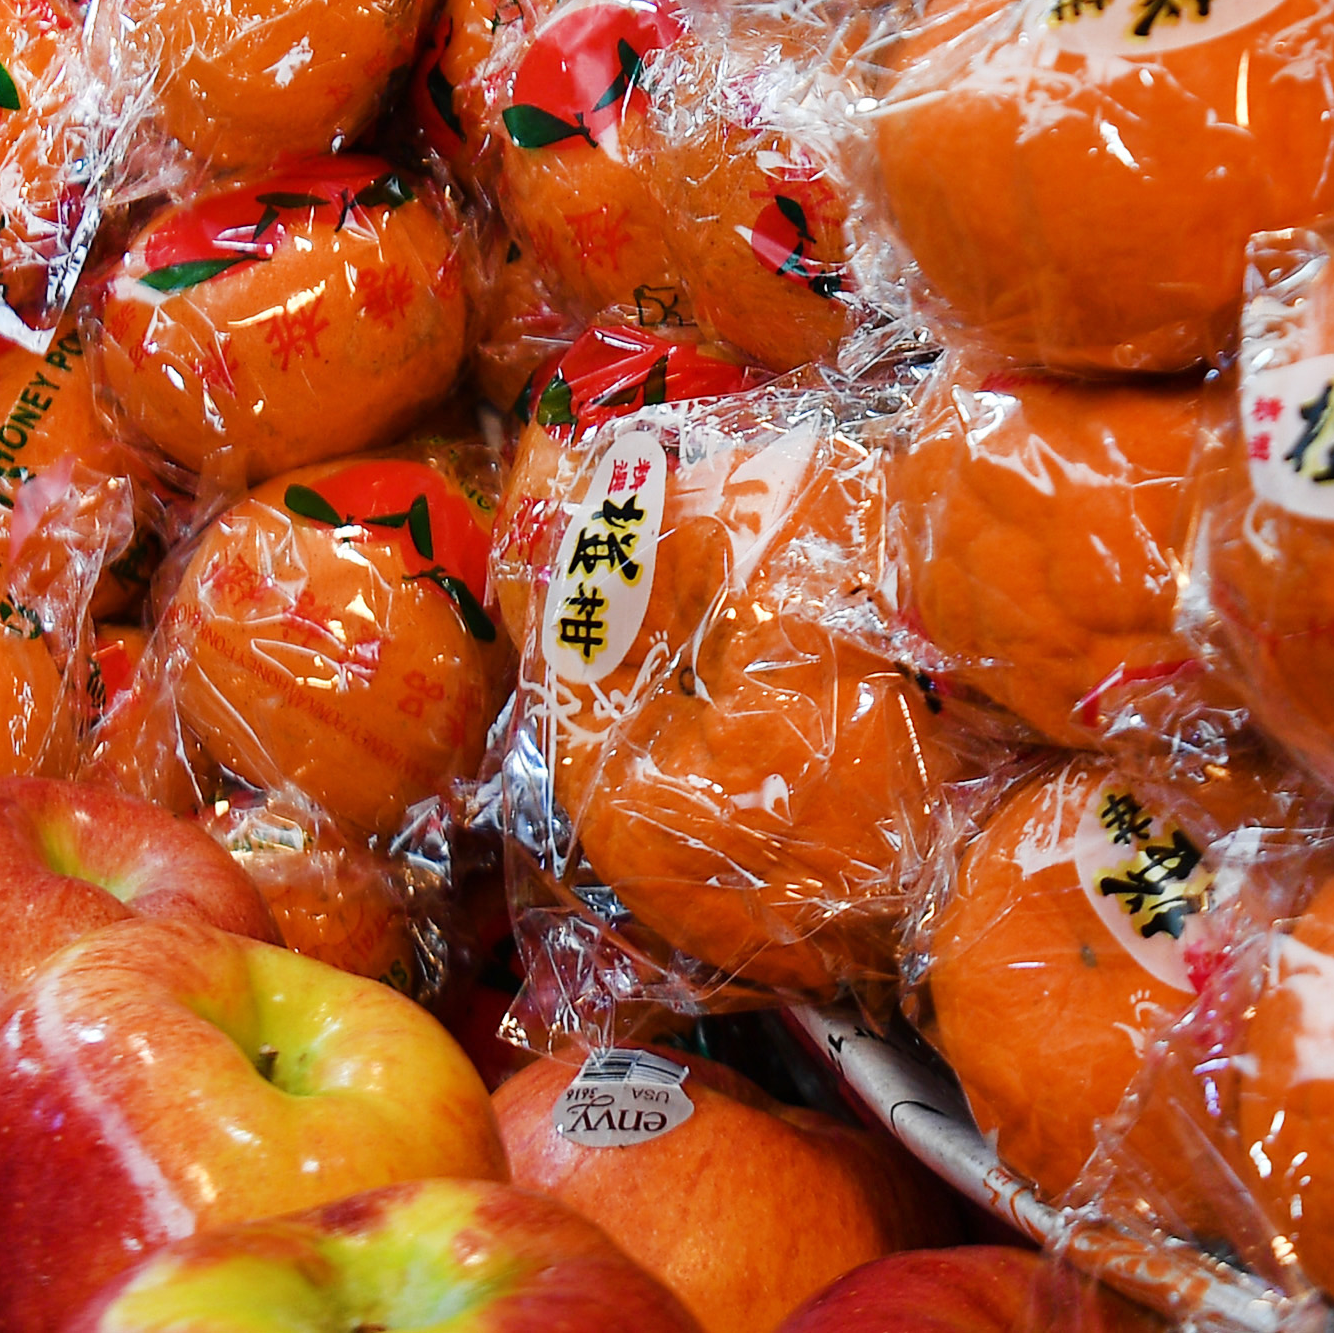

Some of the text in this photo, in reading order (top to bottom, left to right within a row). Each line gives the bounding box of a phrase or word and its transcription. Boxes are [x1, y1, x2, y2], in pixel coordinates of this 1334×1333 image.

[559, 494, 646, 659] 椪柑
[569, 1094, 668, 1134] envy
[631, 1087, 671, 1105] USA
